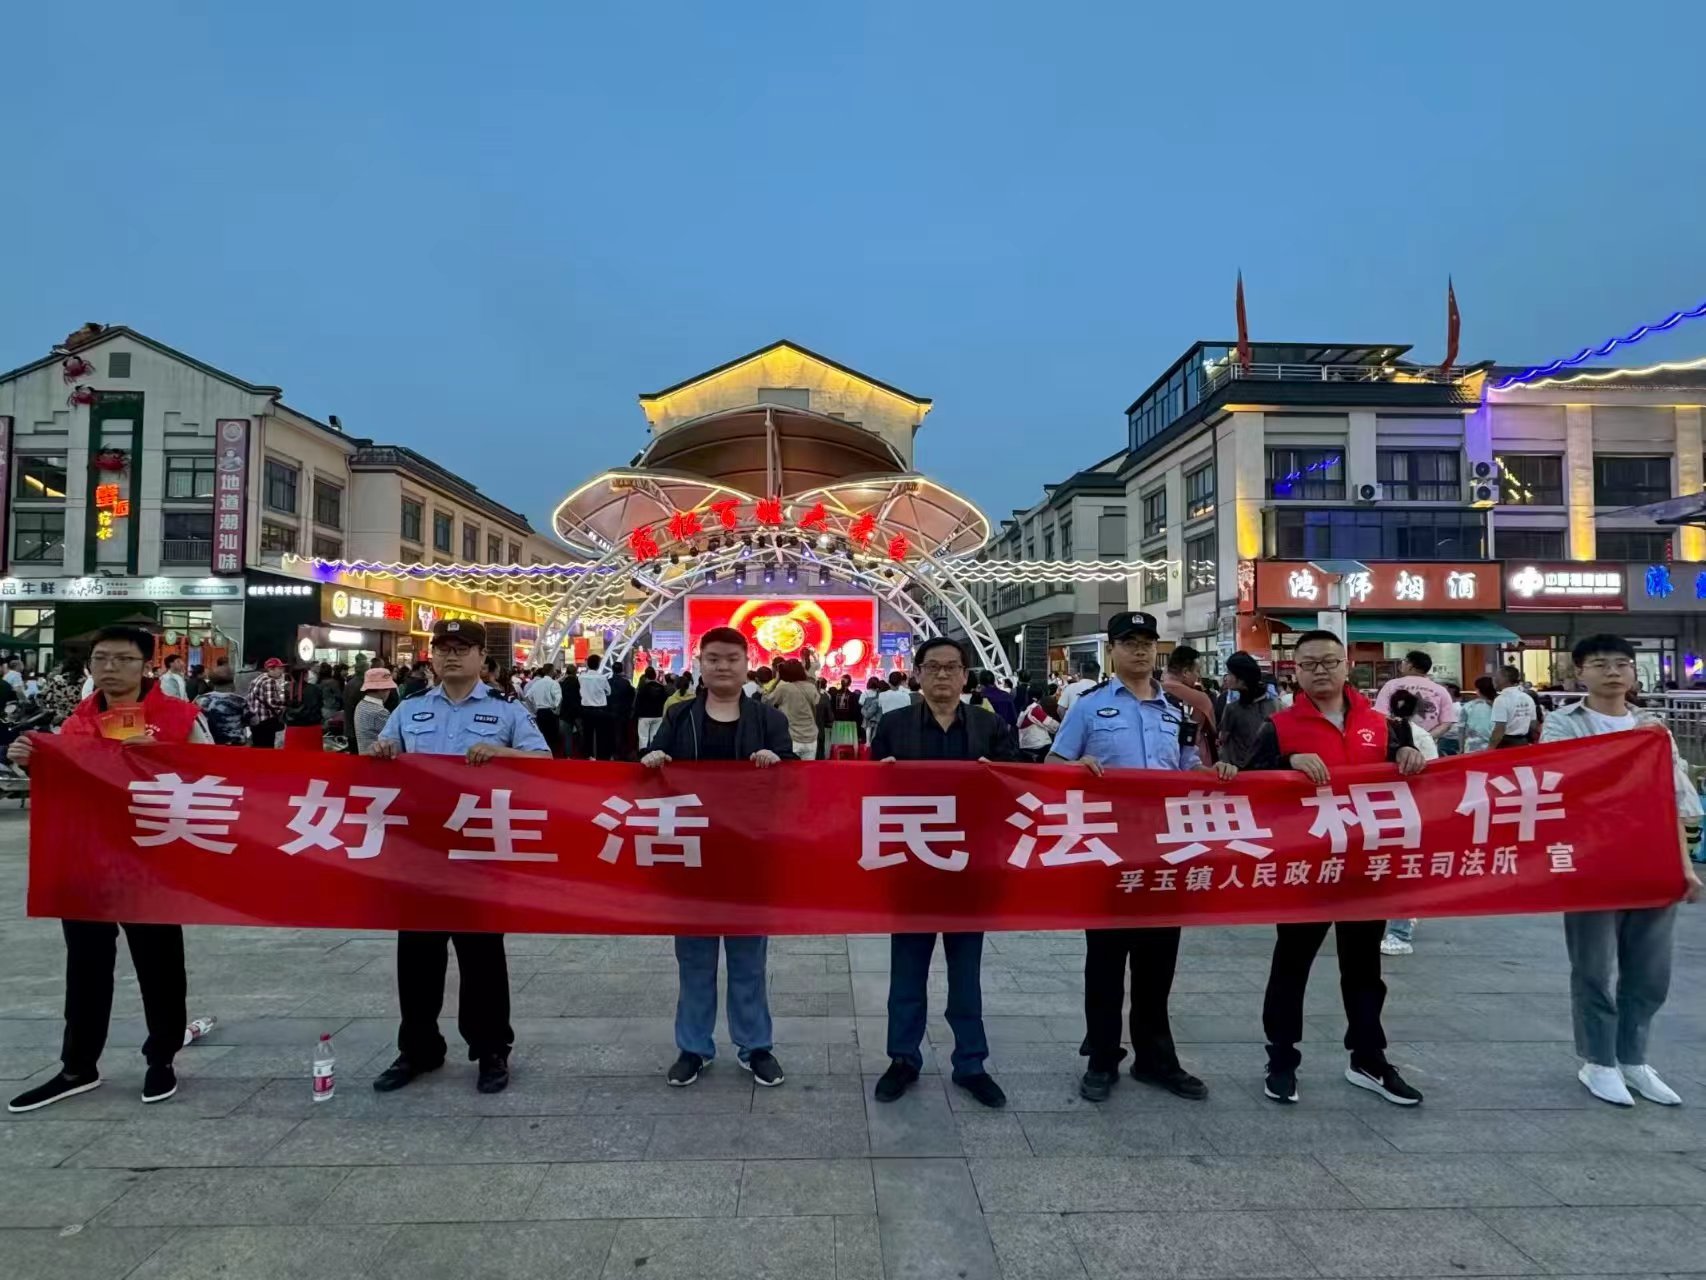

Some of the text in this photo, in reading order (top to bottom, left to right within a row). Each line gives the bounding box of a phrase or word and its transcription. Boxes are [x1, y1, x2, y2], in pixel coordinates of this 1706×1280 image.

[217, 474, 243, 570] 地道潮汕味
[1288, 567, 1478, 604] 鸿伟烟酒
[128, 766, 1567, 872] 美好生活 民法典相伴
[1116, 842, 1577, 894] 孚玉镇人民政府 孚玉司法所 宣
